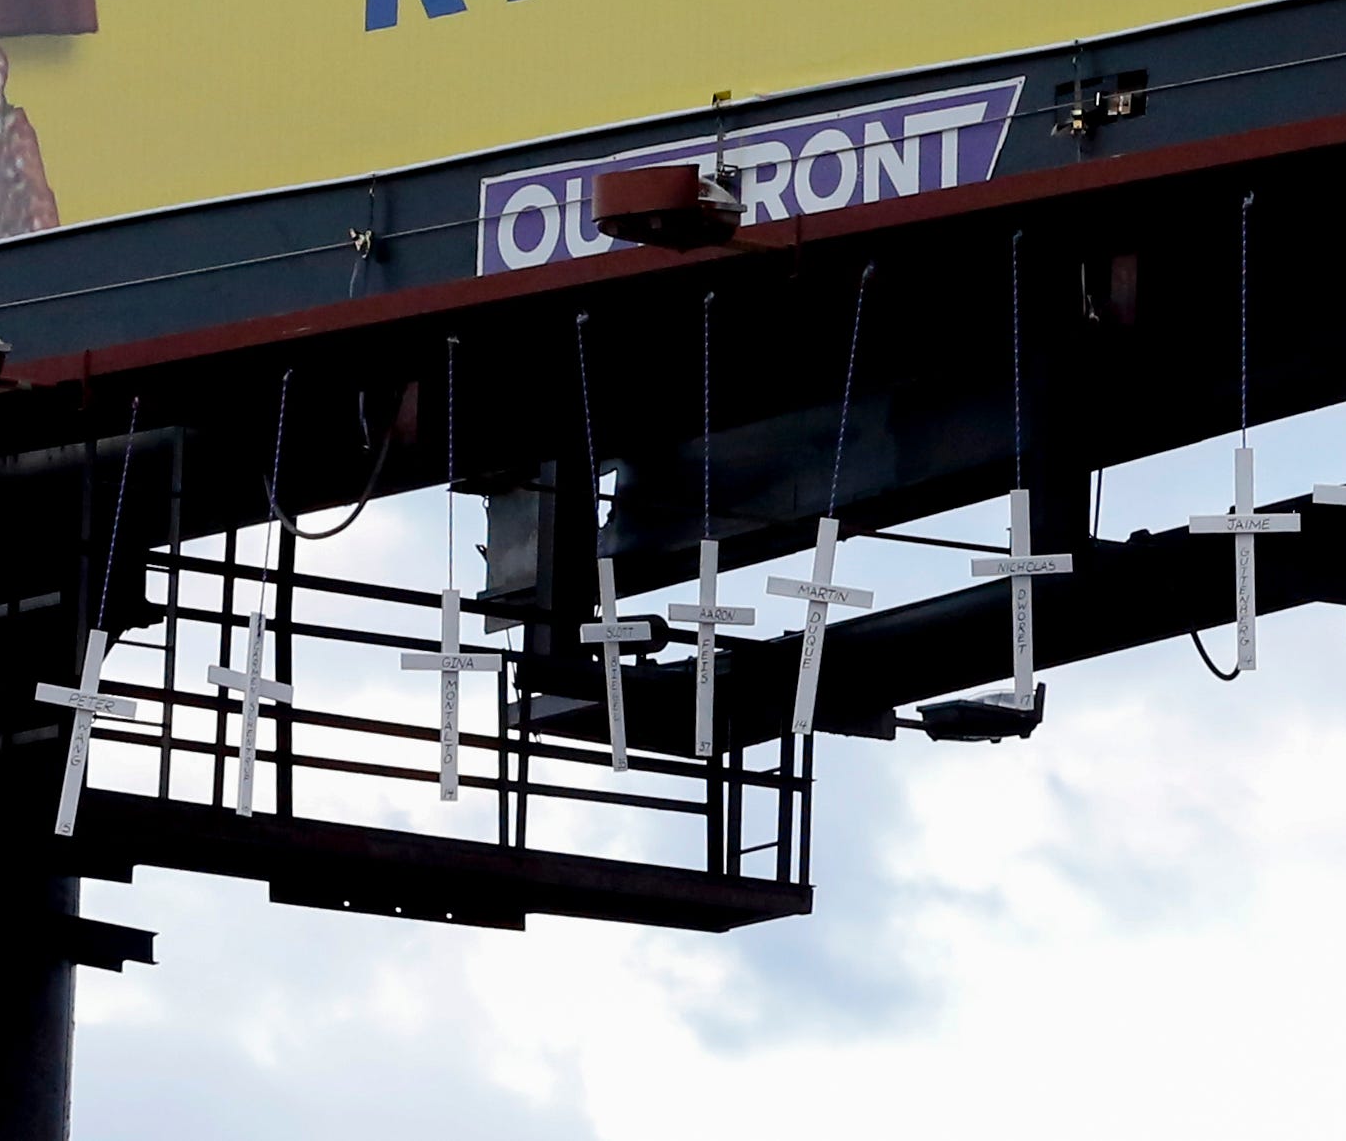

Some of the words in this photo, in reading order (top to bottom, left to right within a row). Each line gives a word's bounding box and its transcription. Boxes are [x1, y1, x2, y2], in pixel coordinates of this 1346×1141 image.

[497, 101, 988, 271] OURONT
[1226, 518, 1271, 531] JAIME
[997, 559, 1057, 574] NICHOLAS
[797, 584, 850, 604] MARTIN
[699, 608, 737, 622] AARON
[1016, 588, 1028, 655] DWORET
[802, 611, 822, 670] DUQUE
[441, 656, 475, 670] GINA
[700, 638, 711, 685] FEIS
[68, 691, 117, 714] PETER
[442, 679, 459, 765] MONTALTO
[69, 720, 91, 767] WANG
